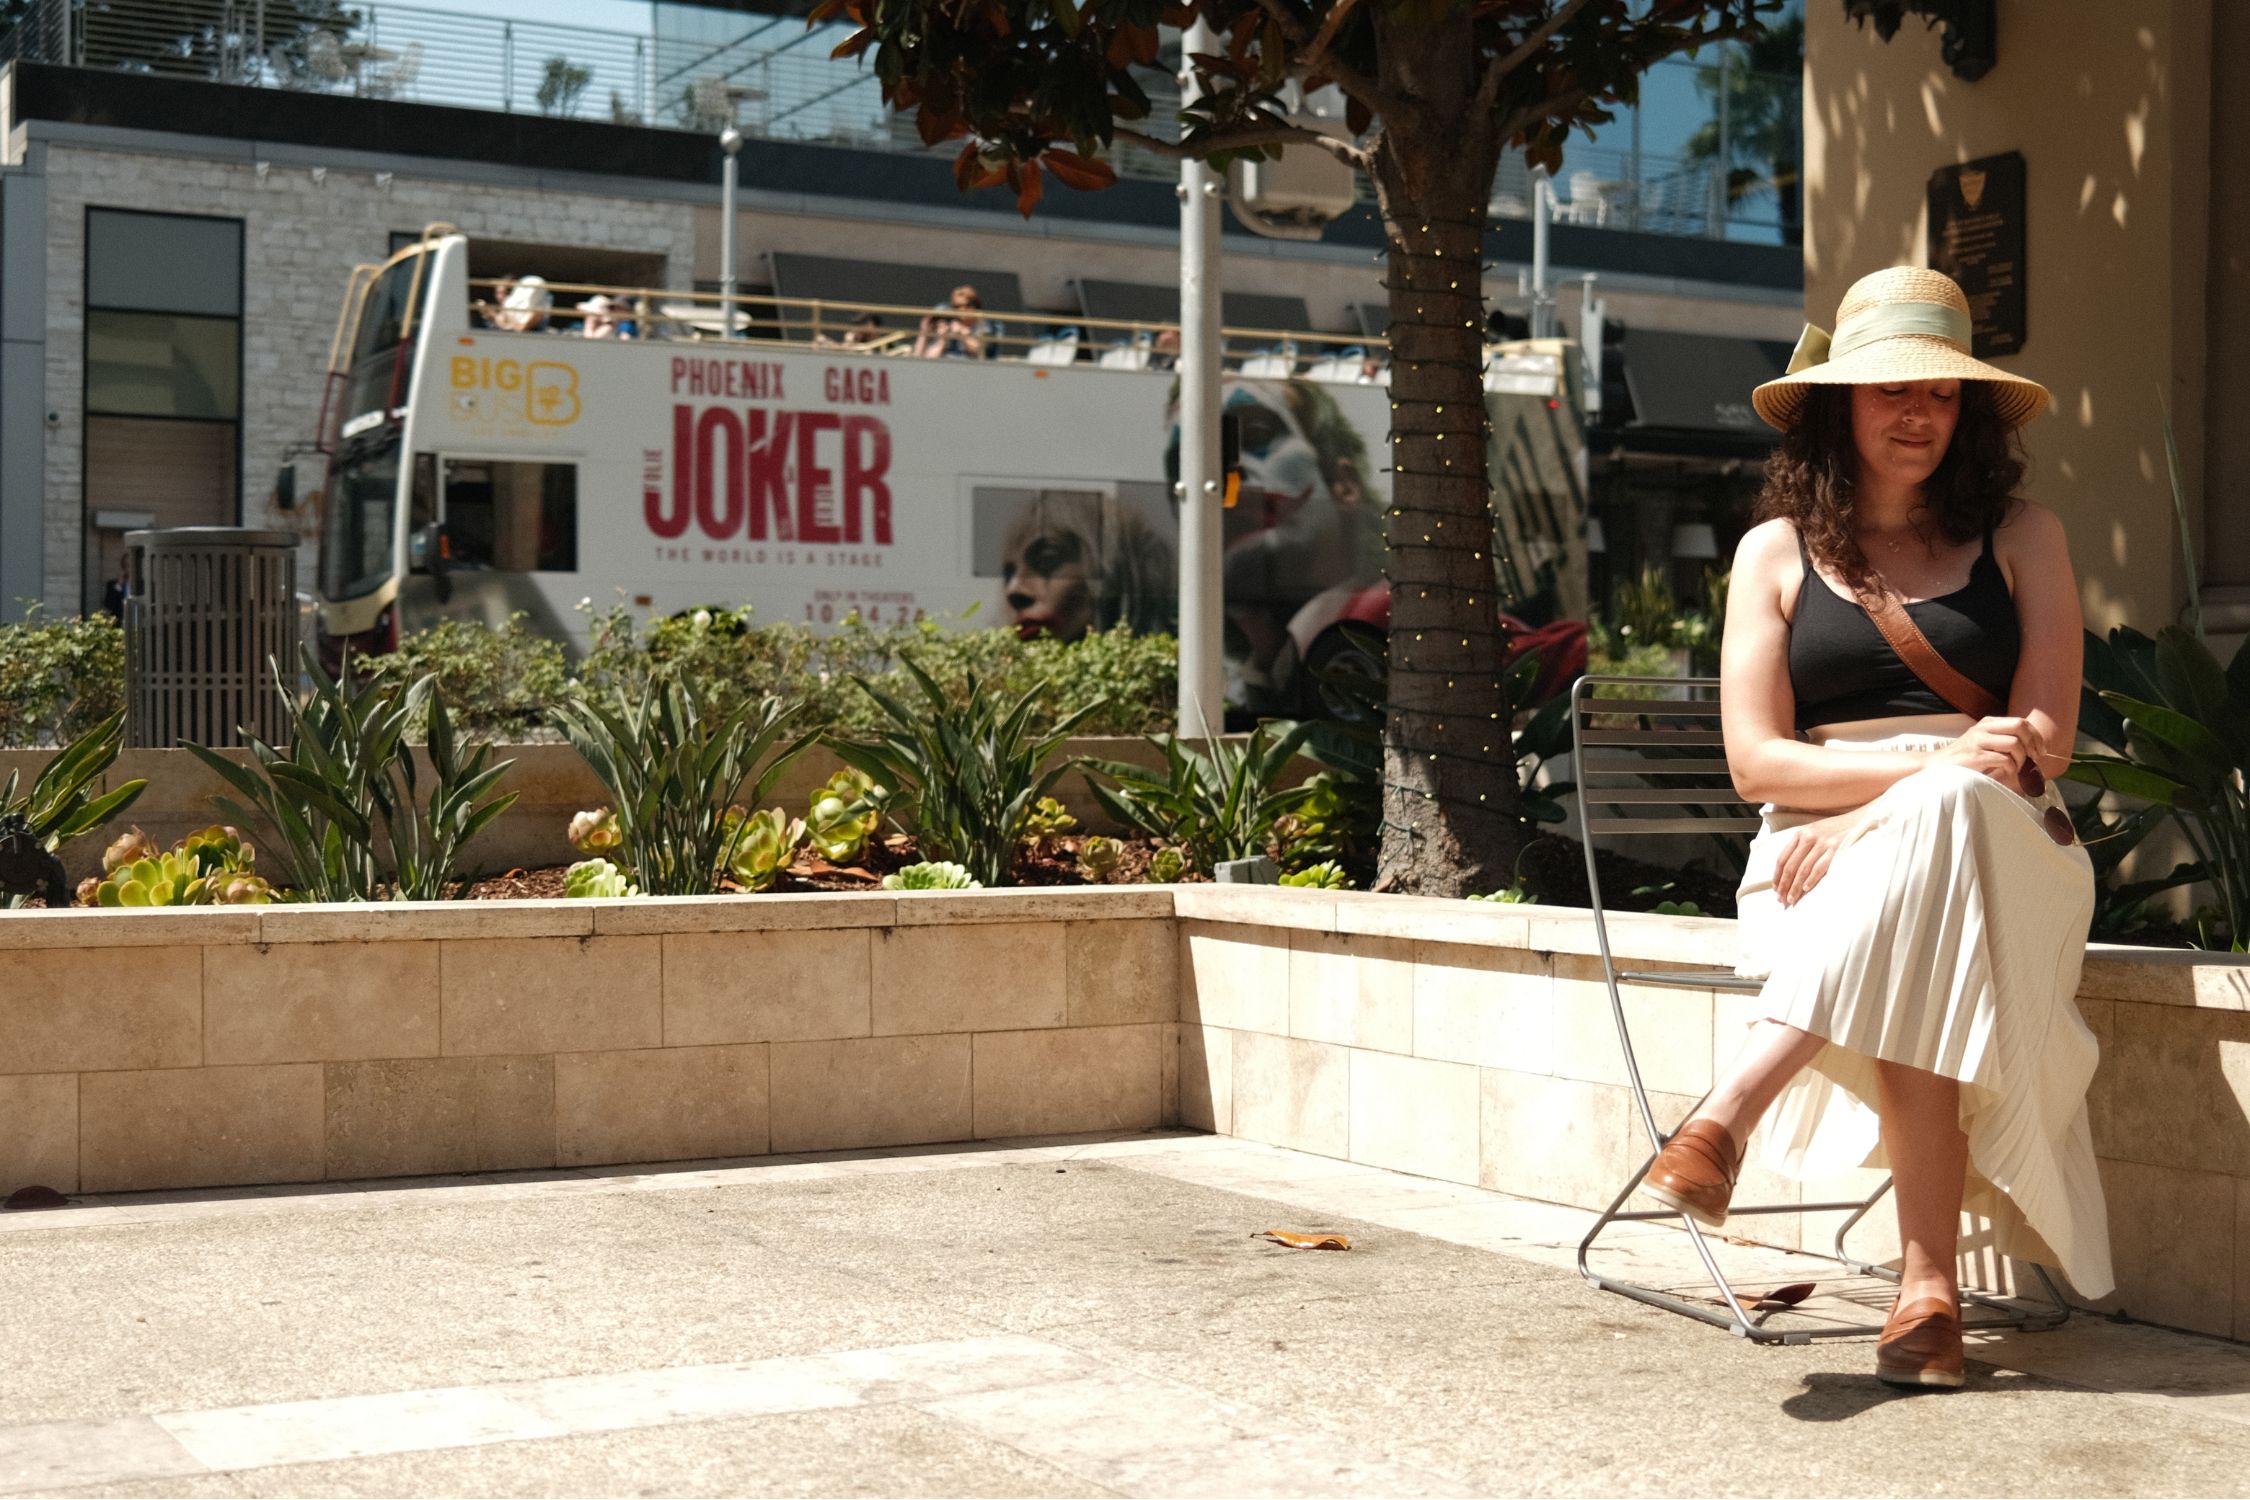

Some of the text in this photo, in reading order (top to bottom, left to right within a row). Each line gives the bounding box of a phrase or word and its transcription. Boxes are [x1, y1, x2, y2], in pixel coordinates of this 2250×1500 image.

[450, 355, 523, 391] BIG
[671, 356, 891, 405] PHOENIX GAGA
[643, 404, 895, 546] JOKER
[656, 547, 884, 568] THE WORLD IS A STAGE
